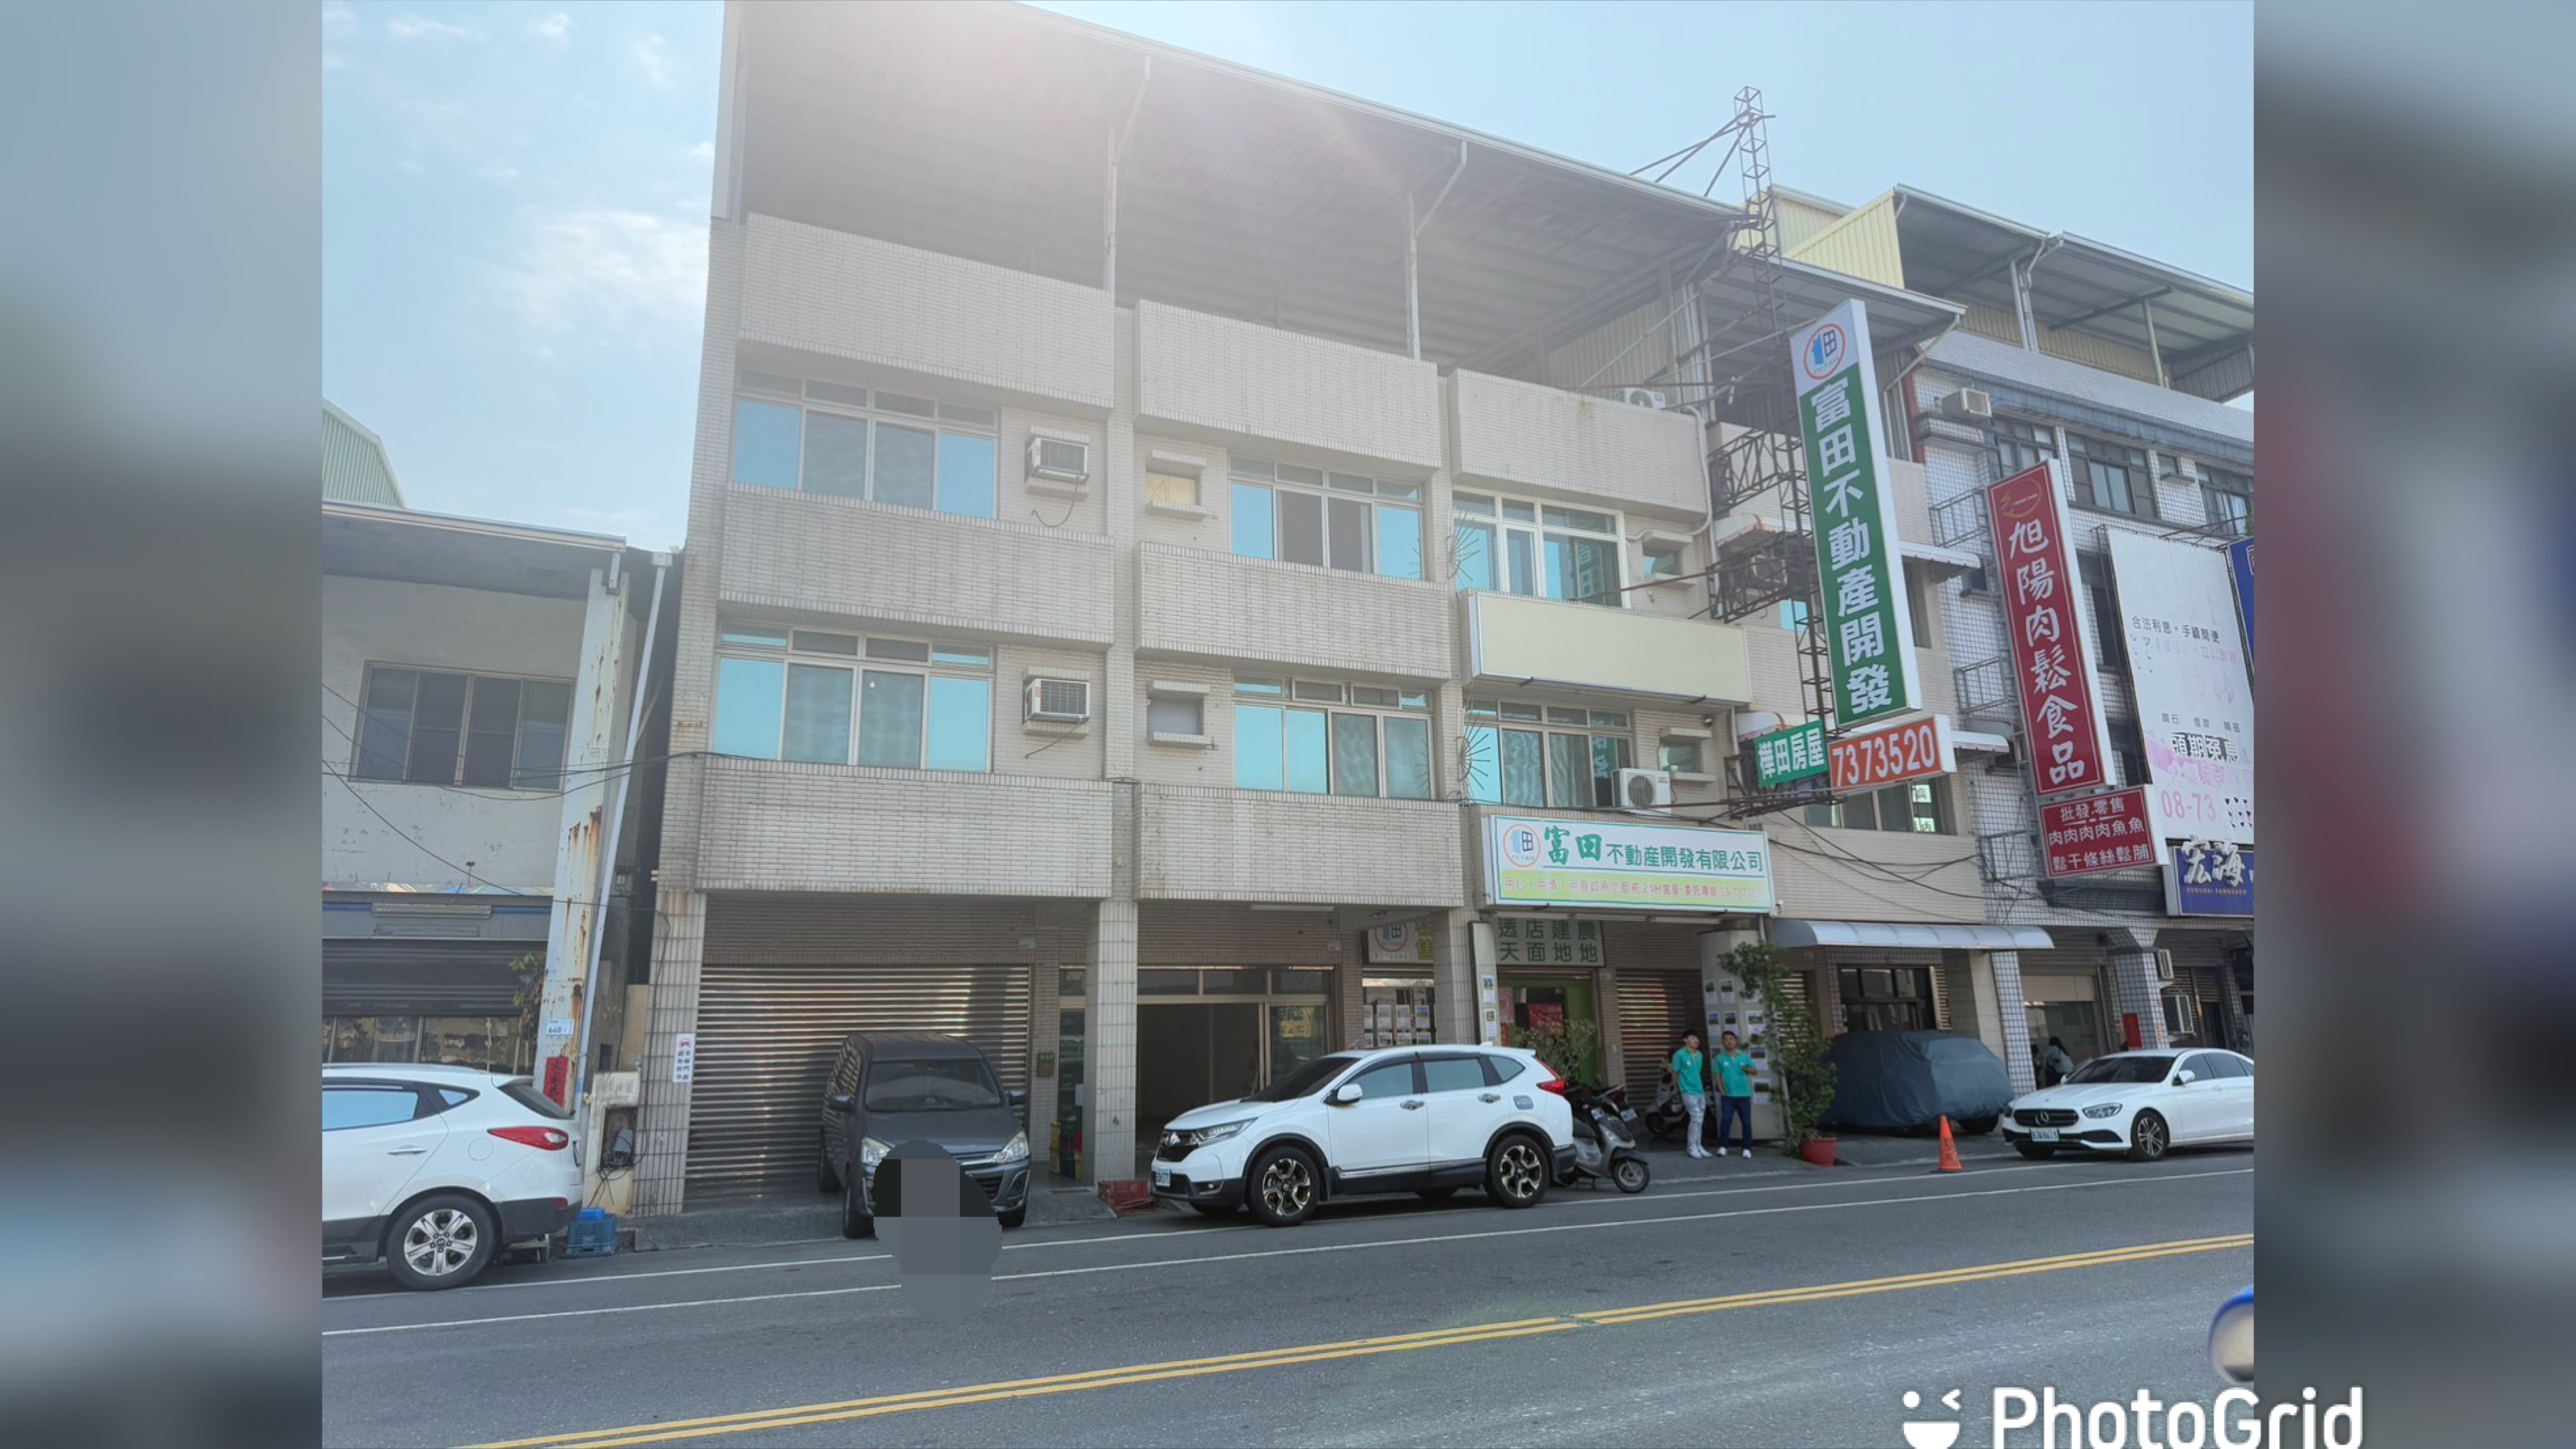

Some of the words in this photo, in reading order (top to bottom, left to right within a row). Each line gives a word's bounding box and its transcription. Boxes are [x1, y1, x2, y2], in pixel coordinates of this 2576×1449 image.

[1811, 376, 1892, 714] 富田不動產開發
[2009, 518, 2084, 785] 旭陽肉鬆食品
[1832, 724, 1935, 787] 7373520
